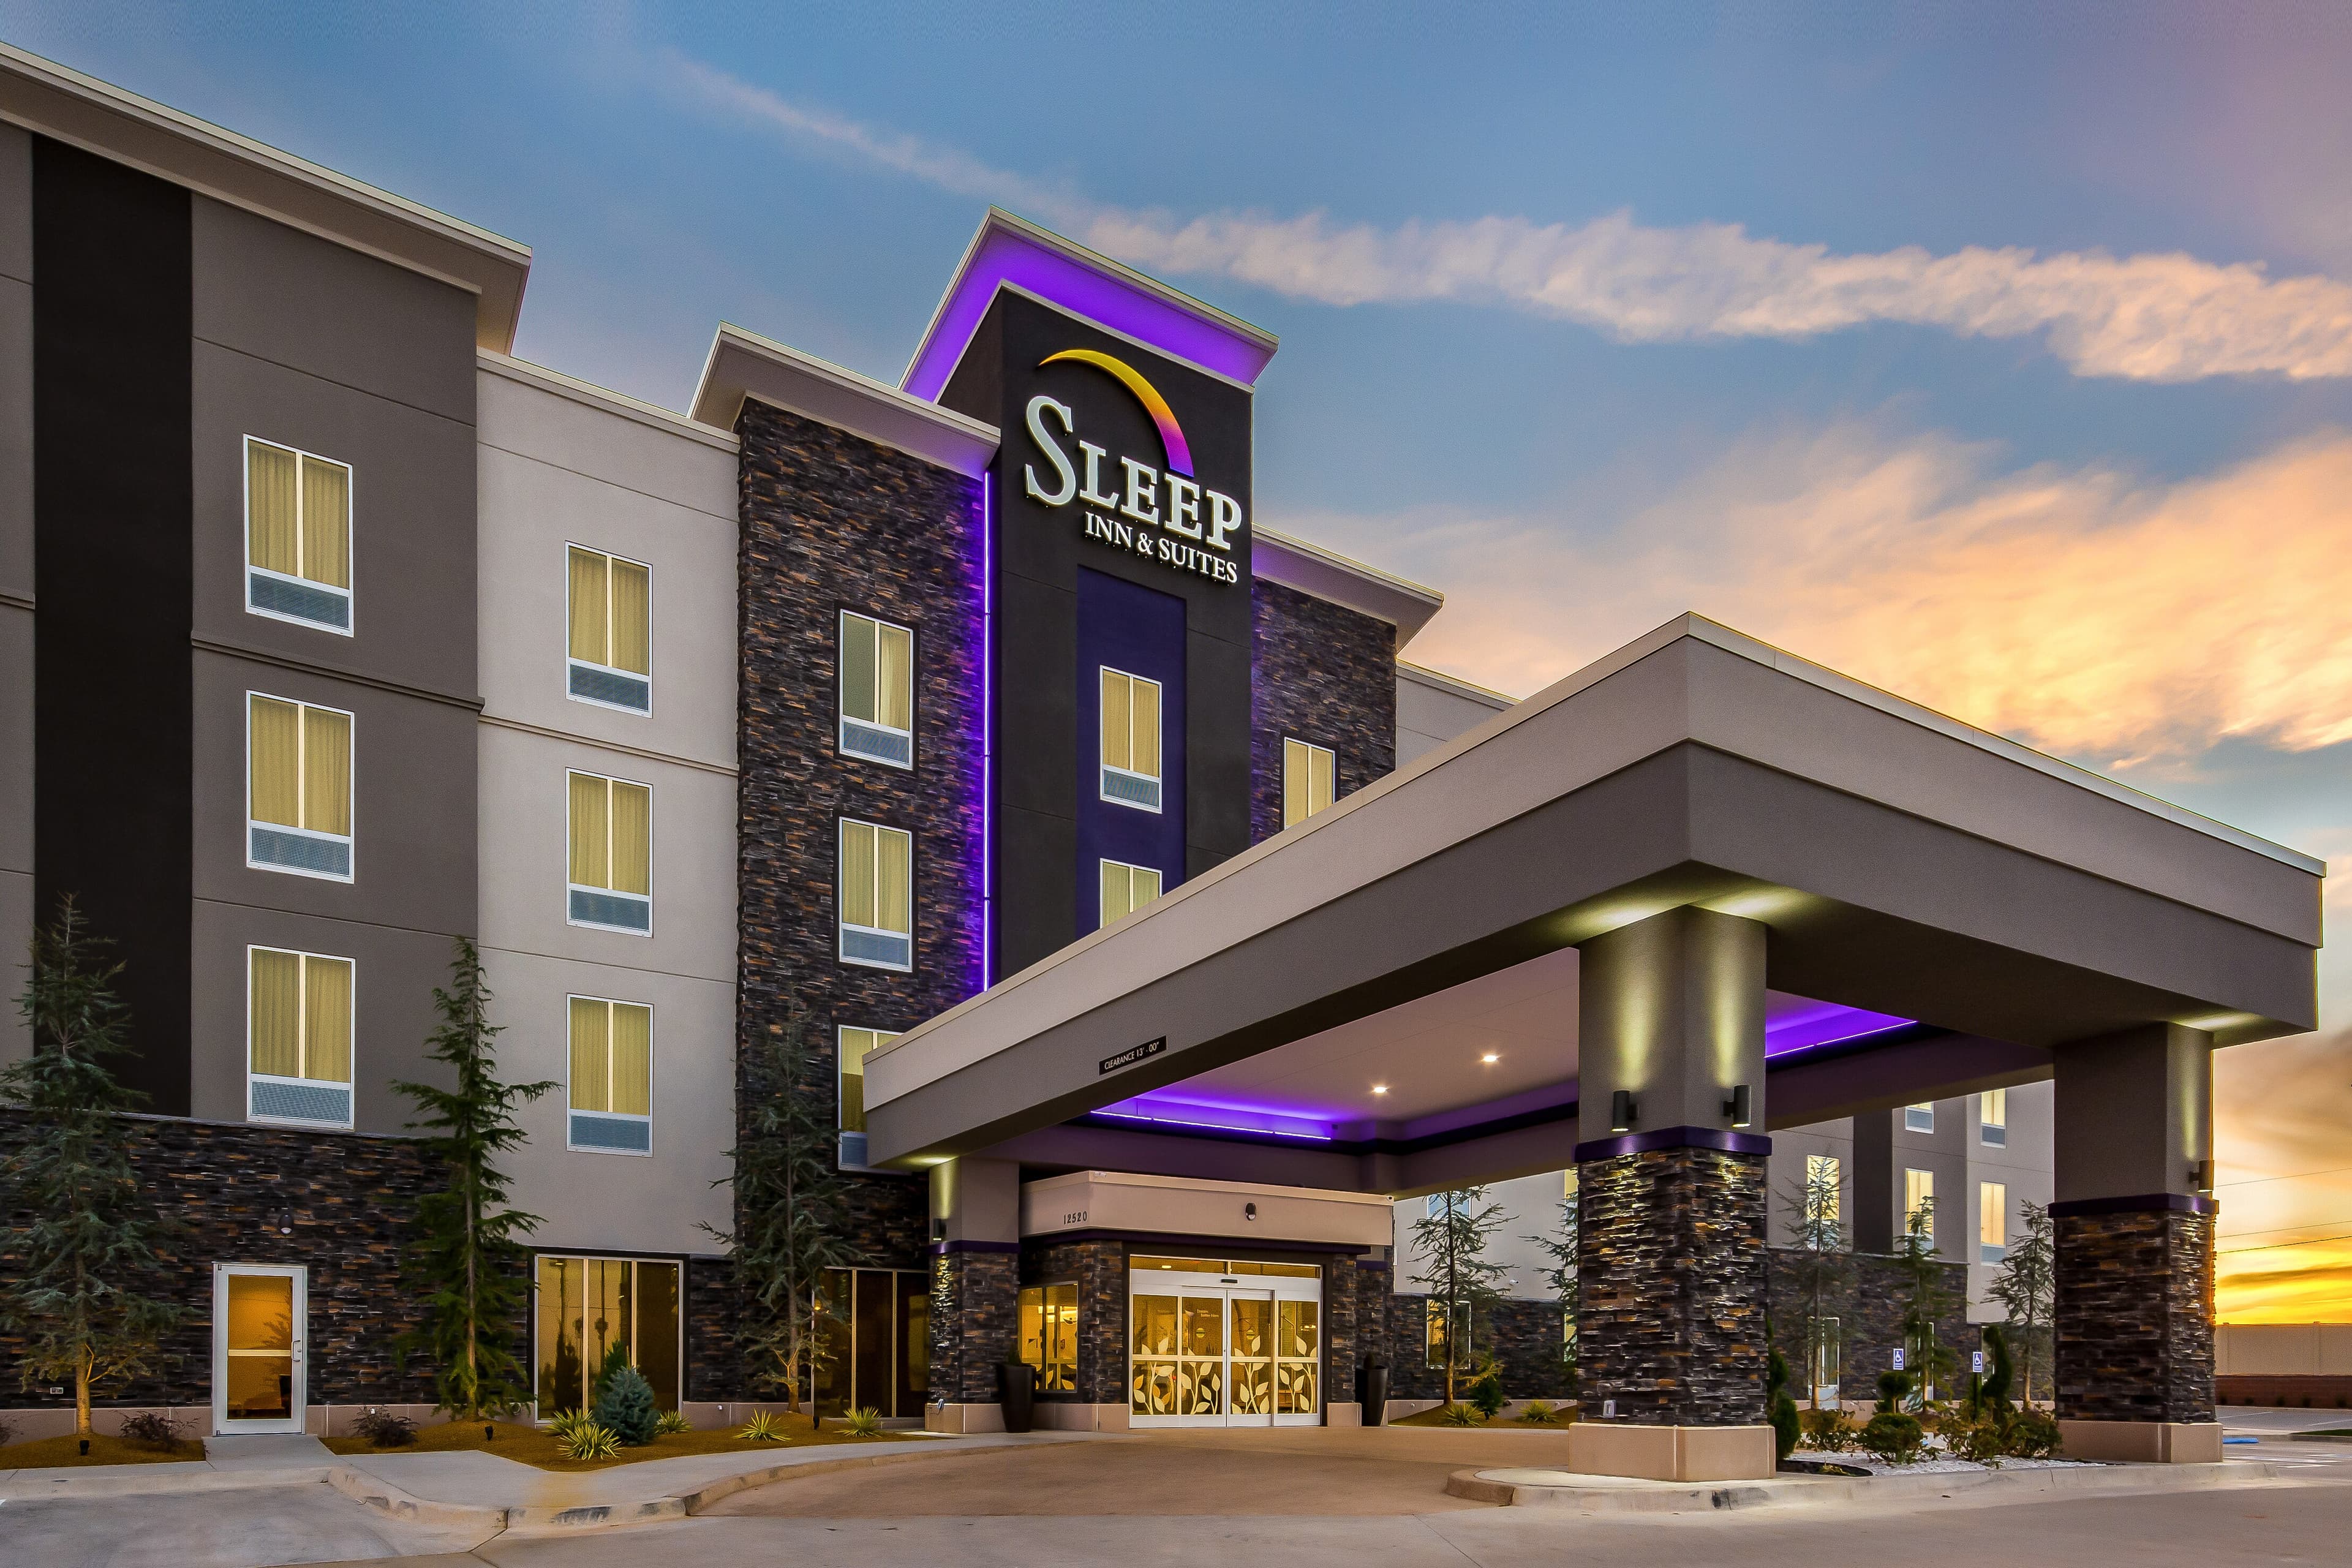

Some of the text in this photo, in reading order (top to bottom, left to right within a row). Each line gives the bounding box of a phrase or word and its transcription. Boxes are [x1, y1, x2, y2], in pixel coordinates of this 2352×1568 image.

[1025, 395, 1242, 551] SLEEP
[1085, 511, 1238, 584] INN & SUITES
[1104, 1050, 1135, 1070] CLEARANCE
[1063, 1210, 1088, 1226] 12520
